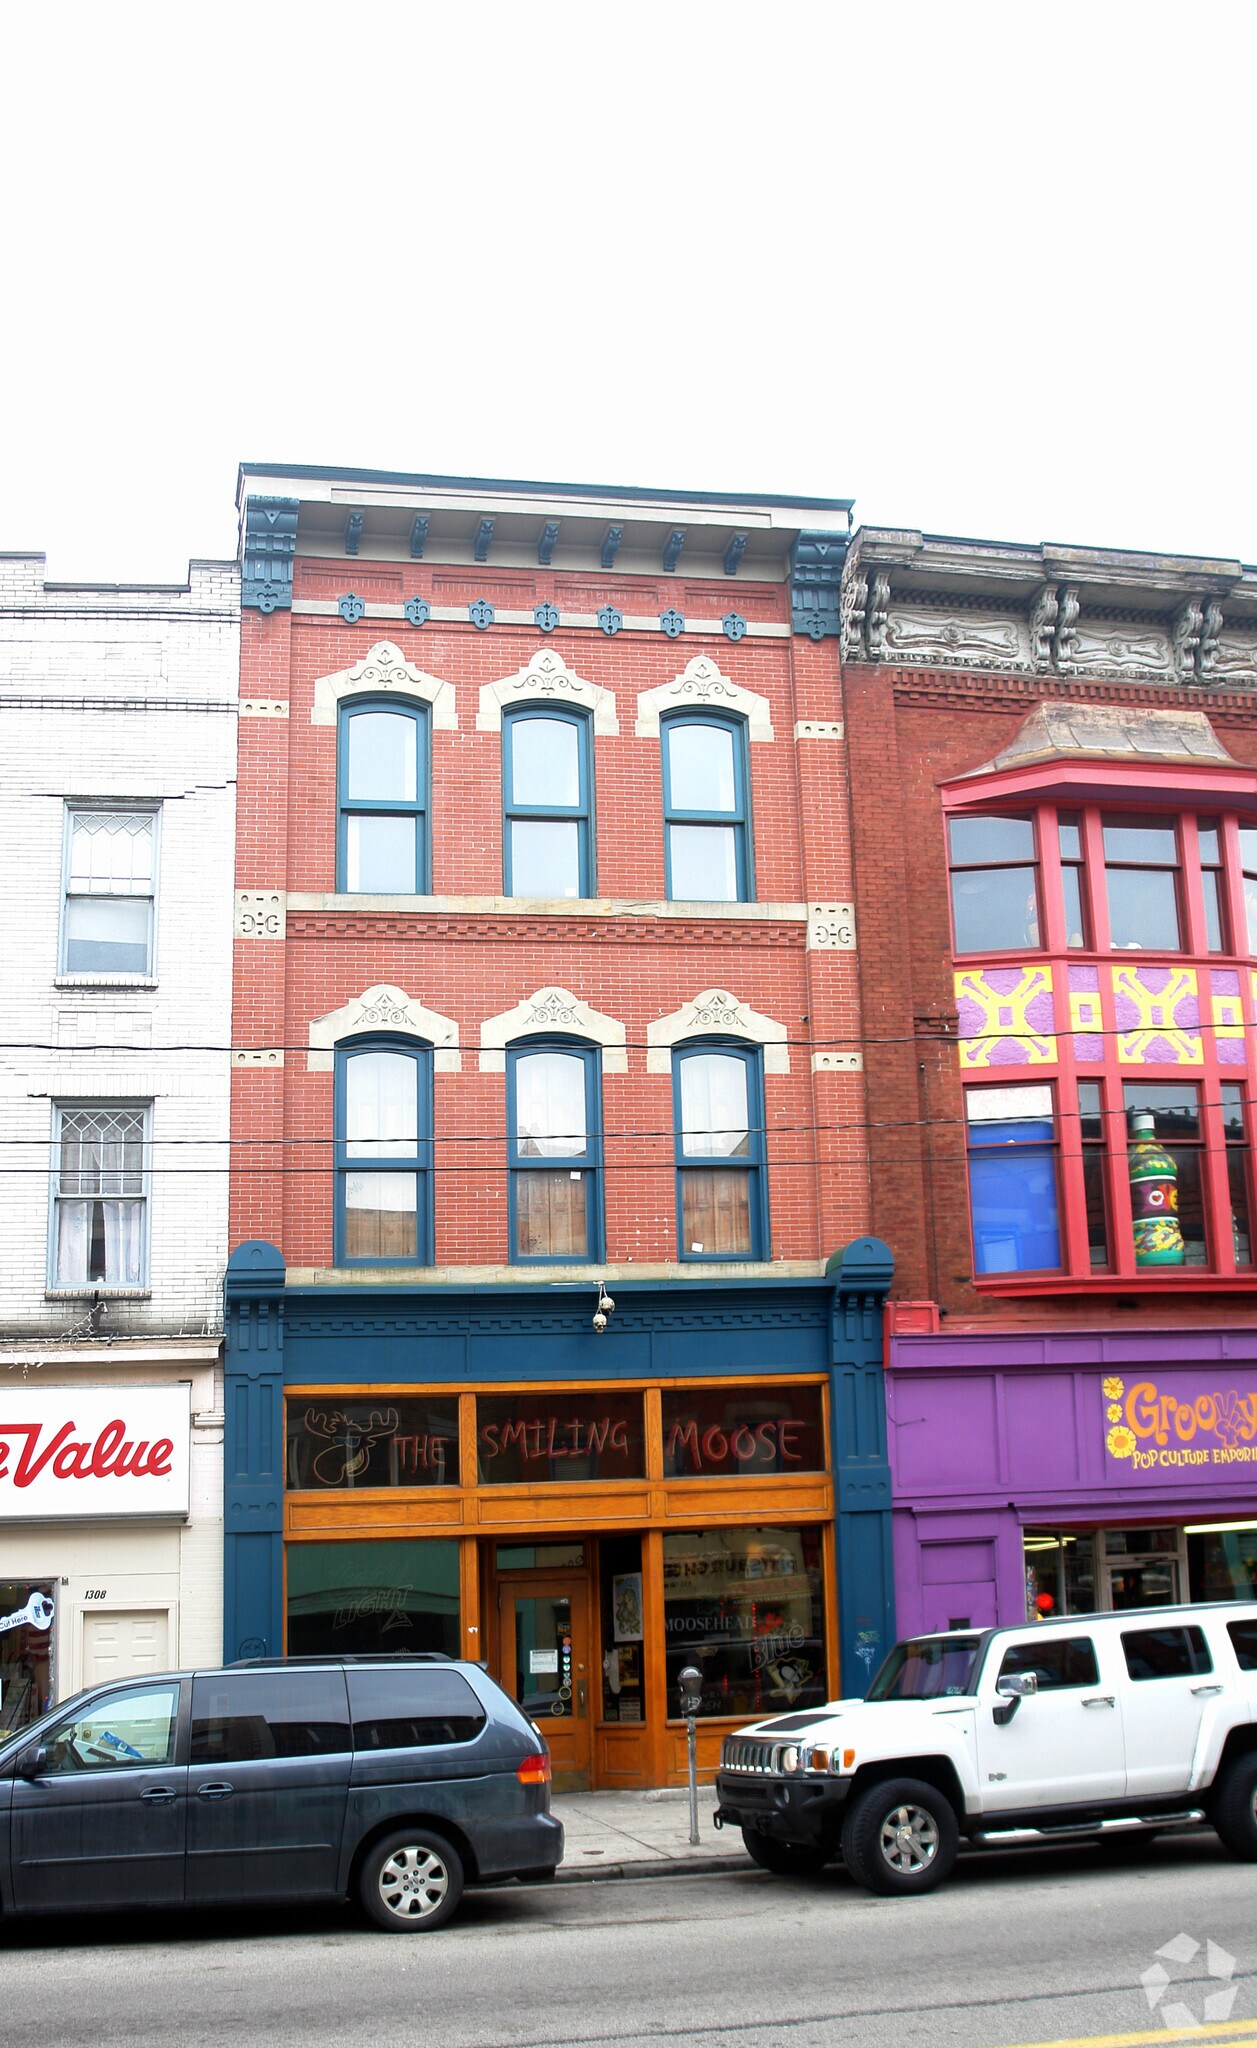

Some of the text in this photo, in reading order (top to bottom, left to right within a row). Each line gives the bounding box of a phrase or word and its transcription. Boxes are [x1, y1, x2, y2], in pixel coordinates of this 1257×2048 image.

[394, 1417, 806, 1473] THE SMILING MOOSE
[1132, 1446, 1257, 1470] POP CULTURE EMPORI
[84, 1589, 107, 1600] 1308
[332, 1584, 414, 1631] LIGHT
[12, 1615, 28, 1626] Here
[664, 1616, 754, 1632] MOOSEHEAD
[748, 1624, 805, 1672] Blue
